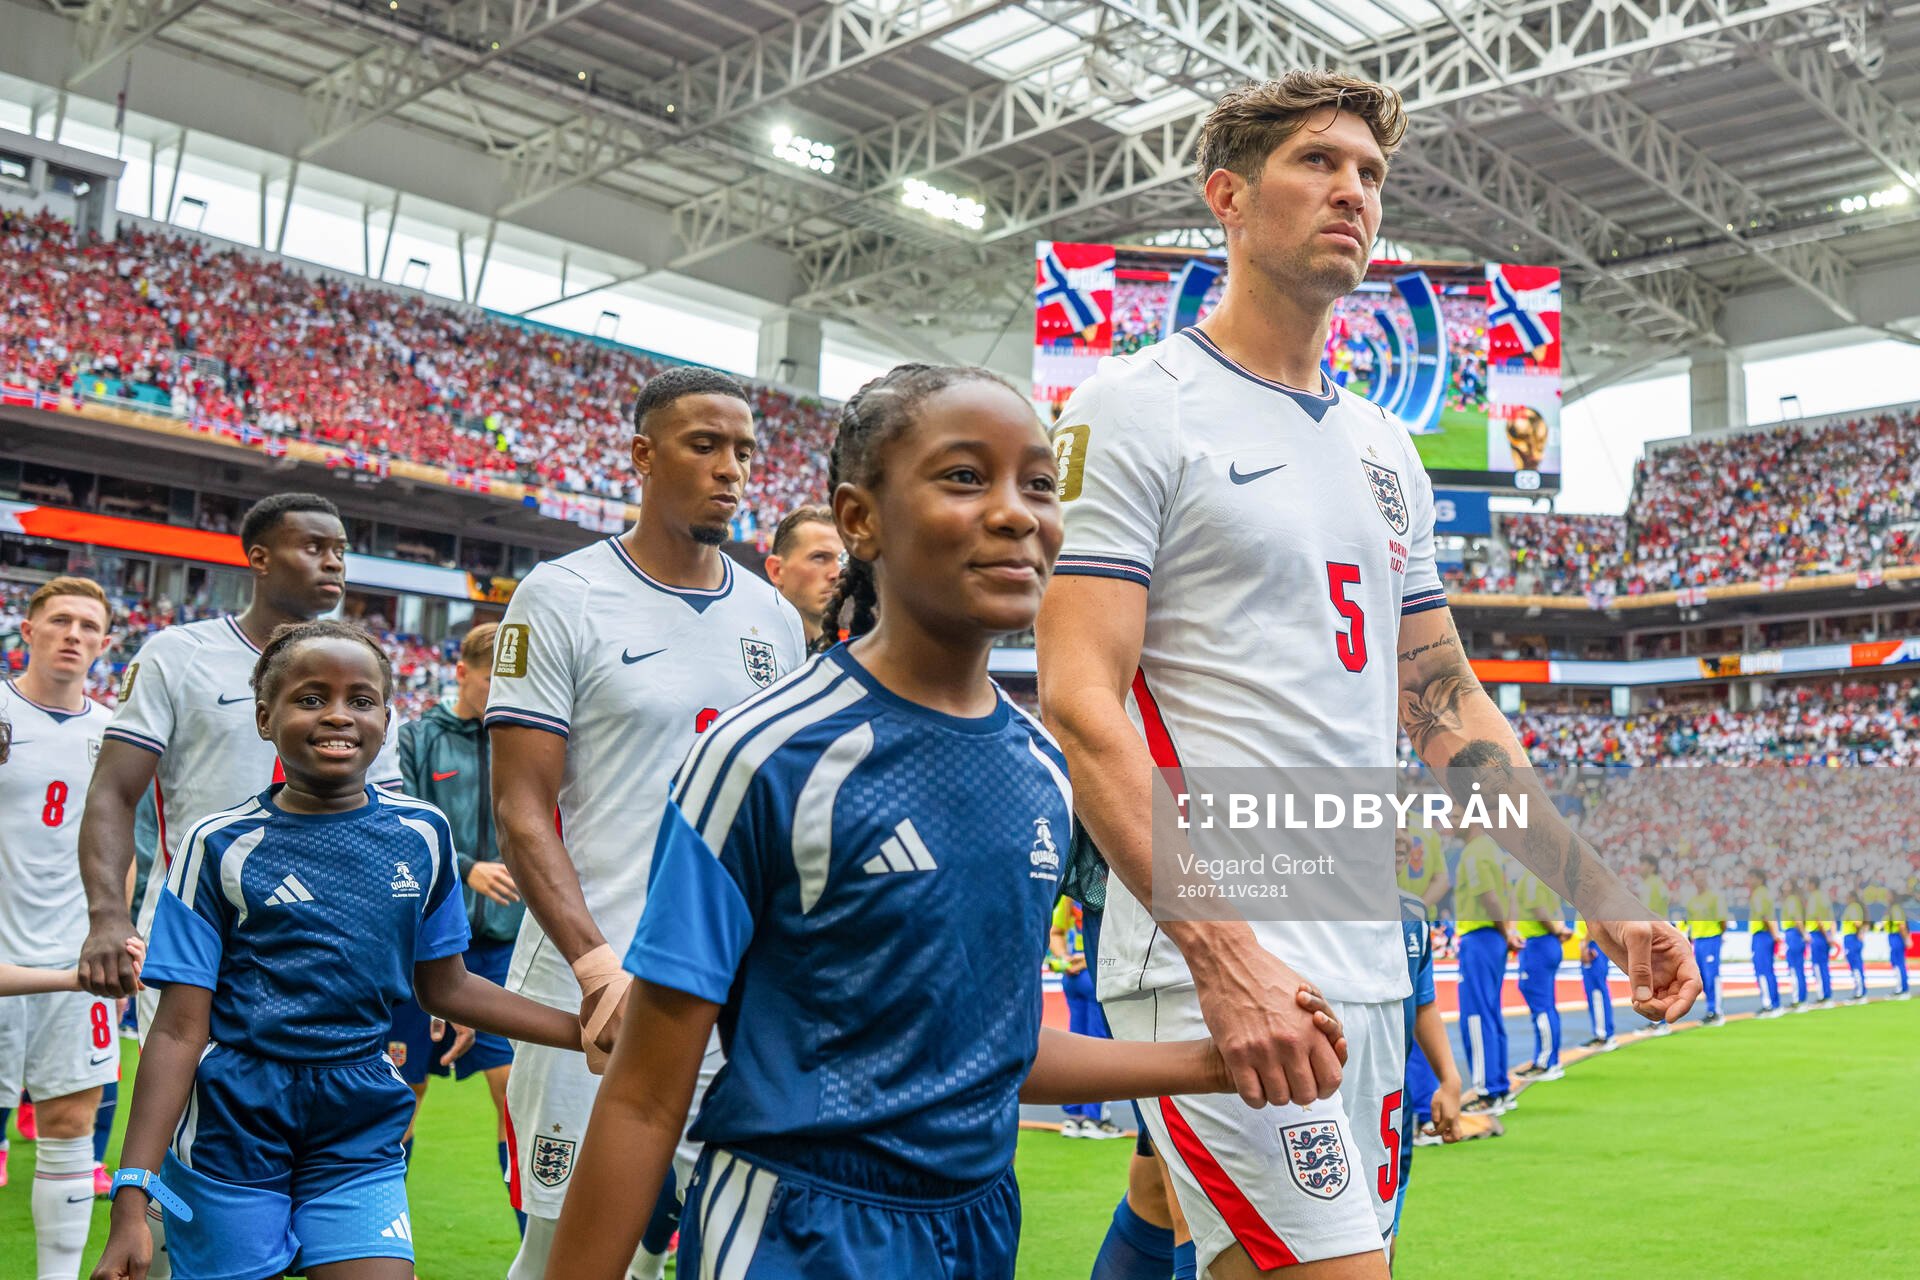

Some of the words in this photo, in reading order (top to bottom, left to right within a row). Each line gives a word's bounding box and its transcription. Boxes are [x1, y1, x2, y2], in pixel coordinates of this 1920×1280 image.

[1326, 560, 1368, 673] 5
[42, 780, 69, 827] 8
[391, 880, 420, 890] QUAKER
[90, 1001, 111, 1049] 8
[1377, 1089, 1402, 1204] 5
[121, 1173, 138, 1181] 093
